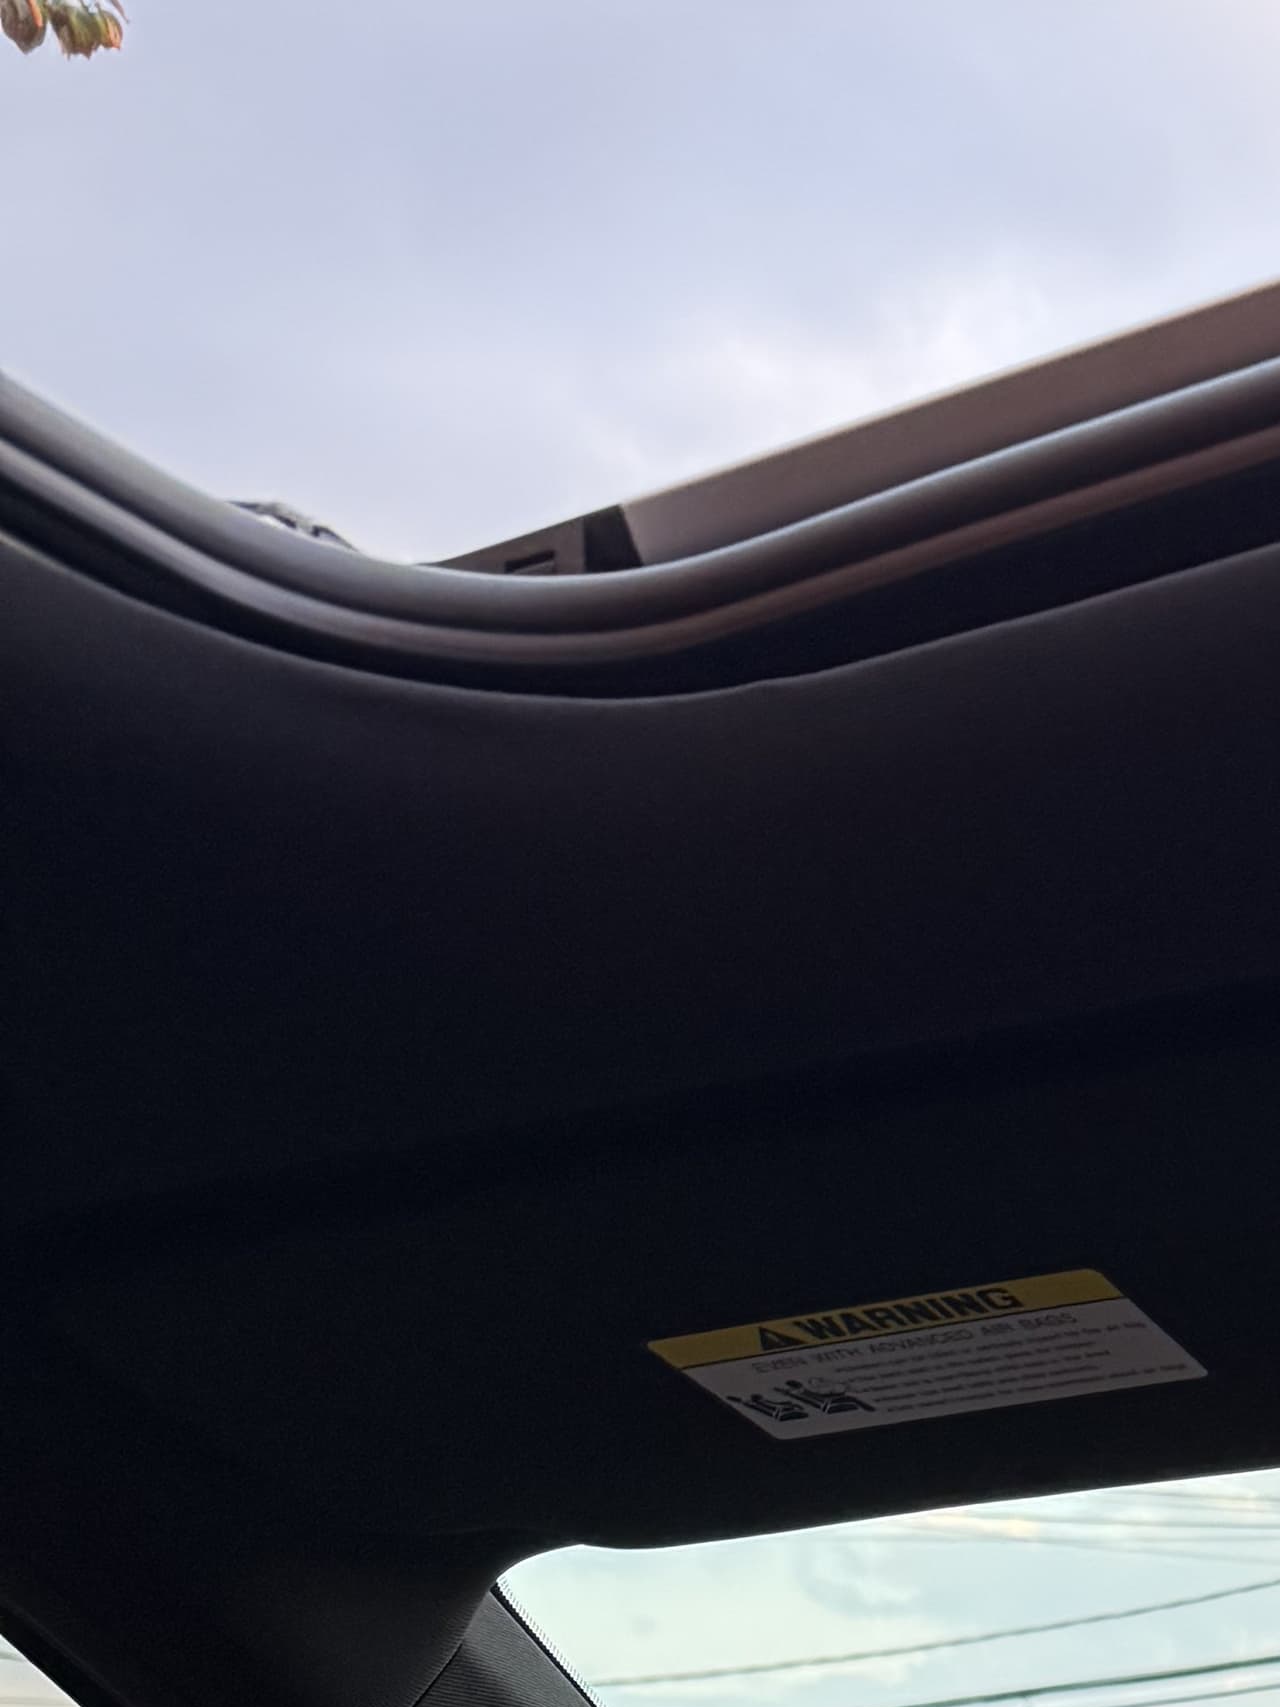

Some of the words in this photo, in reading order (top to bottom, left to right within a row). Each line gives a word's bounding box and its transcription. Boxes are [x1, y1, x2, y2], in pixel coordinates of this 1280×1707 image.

[793, 1286, 1024, 1342] WARNING
[868, 1329, 976, 1355] ADVANCED
[981, 1320, 1015, 1337] AIR
[1022, 1311, 1077, 1332] BAGS
